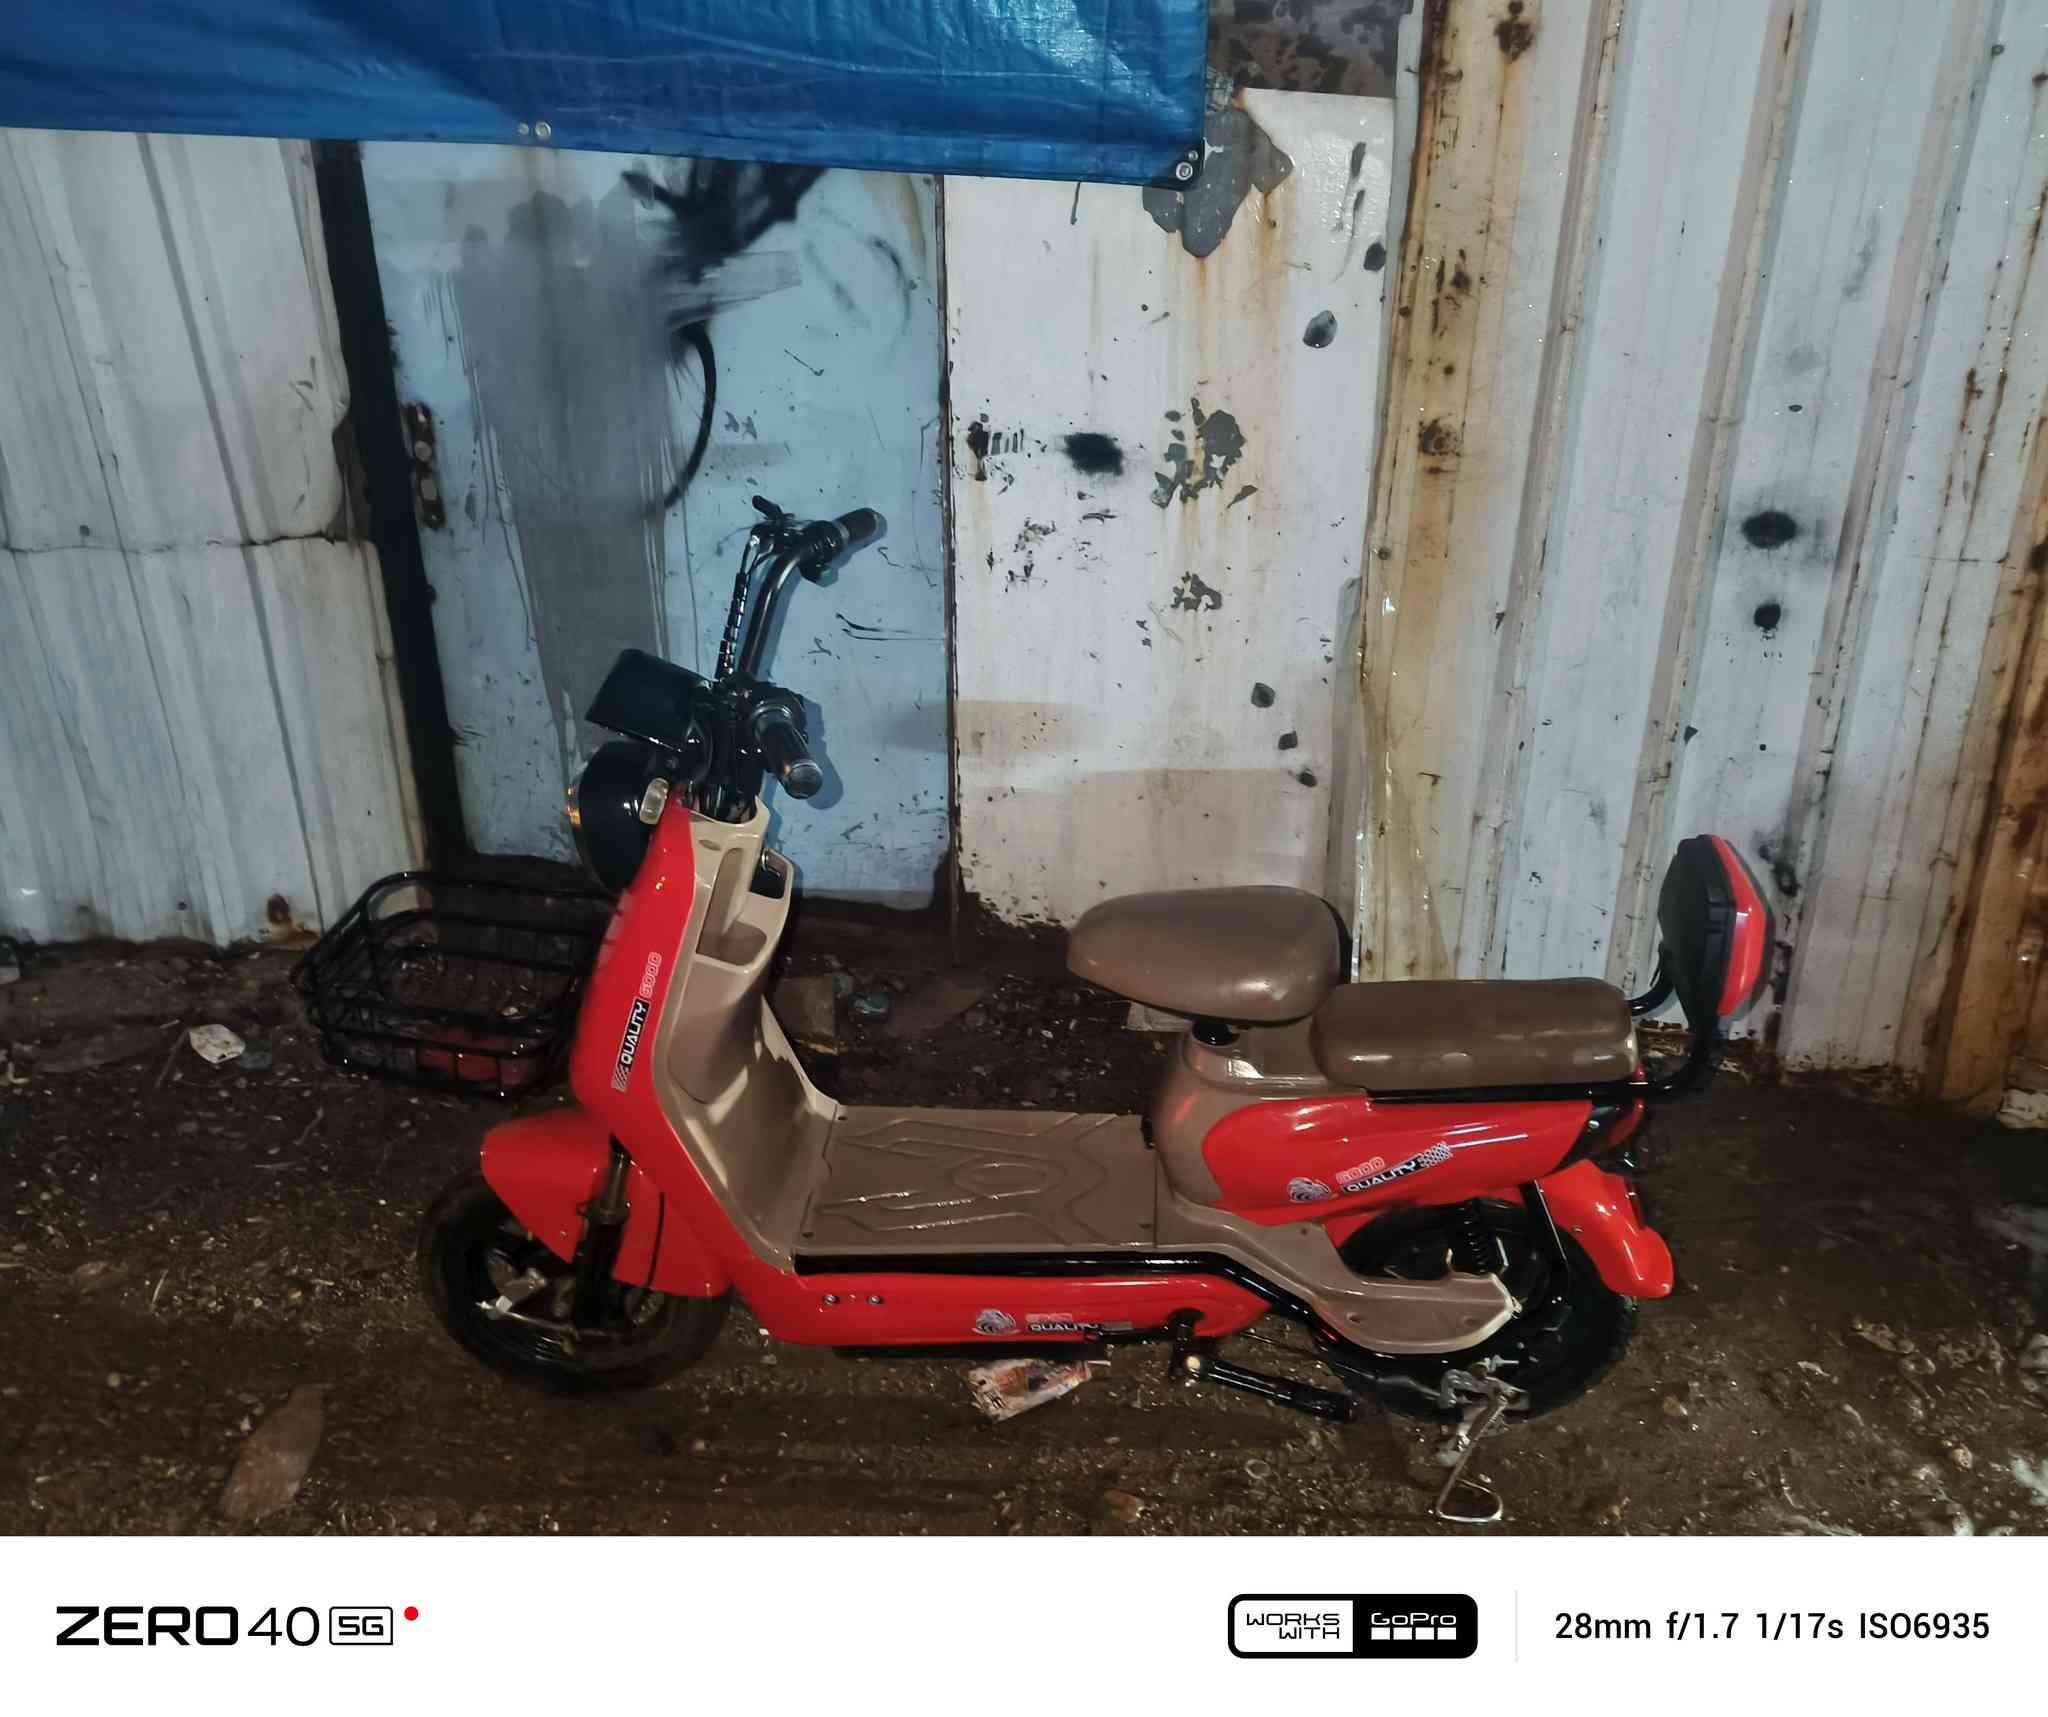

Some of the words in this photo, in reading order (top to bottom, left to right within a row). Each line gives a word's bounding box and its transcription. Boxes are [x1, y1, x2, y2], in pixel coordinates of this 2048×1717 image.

[621, 1001, 647, 1066] QUALITY
[1345, 1160, 1417, 1193] QUALITY
[1030, 1322, 1099, 1333] QUALITY
